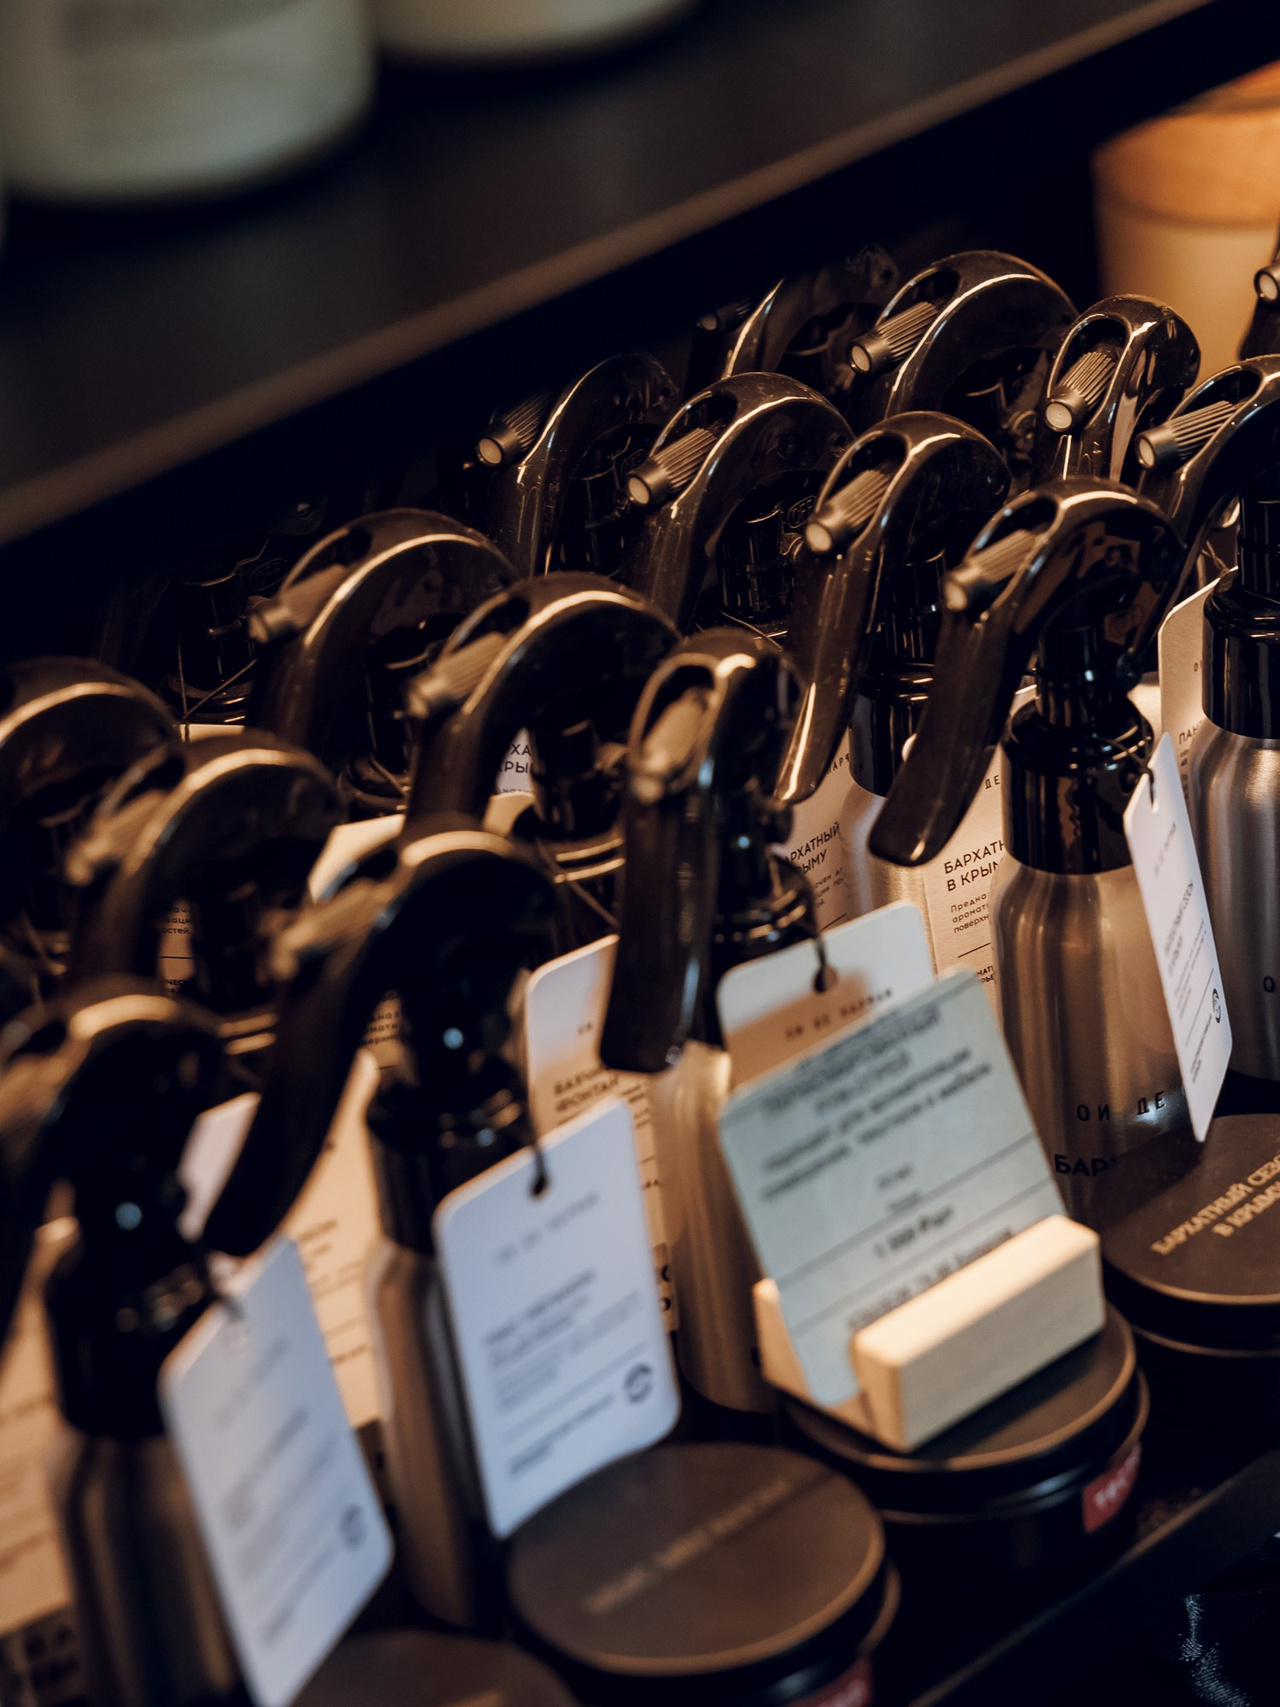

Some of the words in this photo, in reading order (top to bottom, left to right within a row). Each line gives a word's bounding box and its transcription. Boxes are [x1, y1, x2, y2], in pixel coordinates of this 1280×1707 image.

[946, 879, 957, 892] В
[1076, 1104, 1110, 1122] ОИ
[1136, 1090, 1165, 1117] ДЕ
[1054, 1153, 1115, 1177] БАР
[1150, 1181, 1255, 1256] БАРХАТНЫЙ
